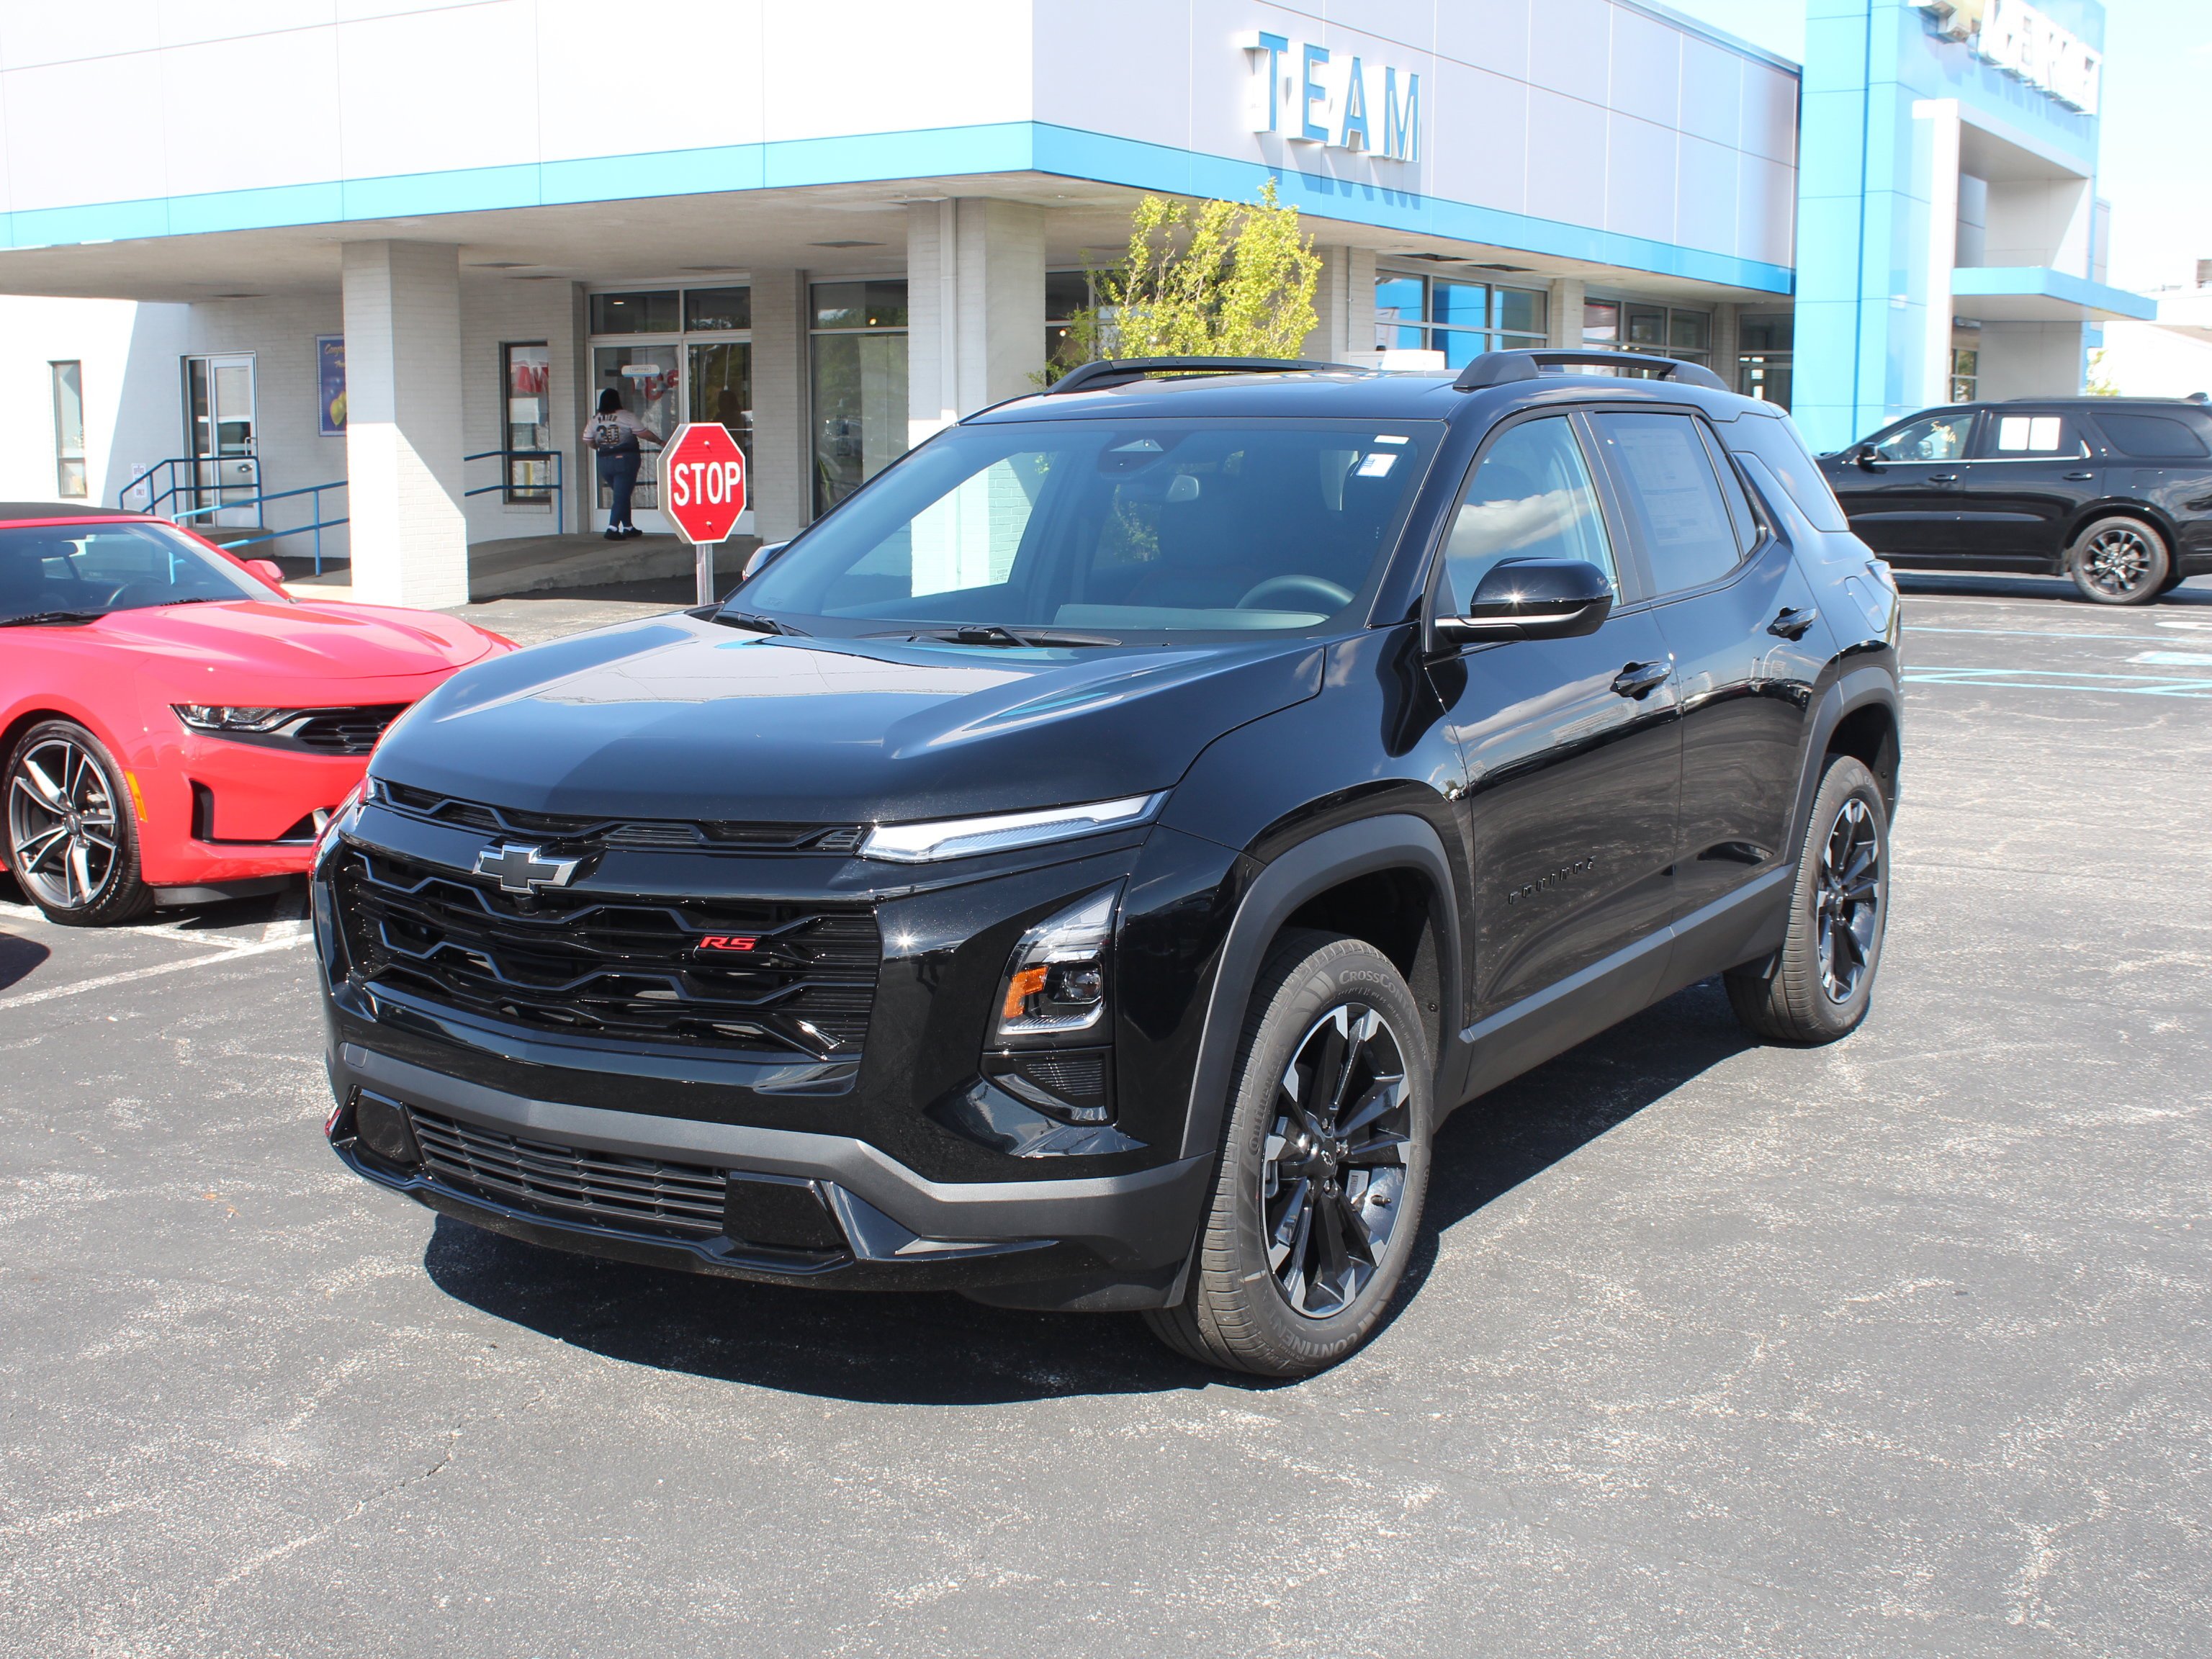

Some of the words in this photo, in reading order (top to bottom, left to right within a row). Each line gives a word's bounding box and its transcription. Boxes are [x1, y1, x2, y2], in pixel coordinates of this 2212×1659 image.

[1249, 30, 1420, 163] TEAM
[673, 462, 741, 507] STOP
[700, 935, 757, 950] RS
